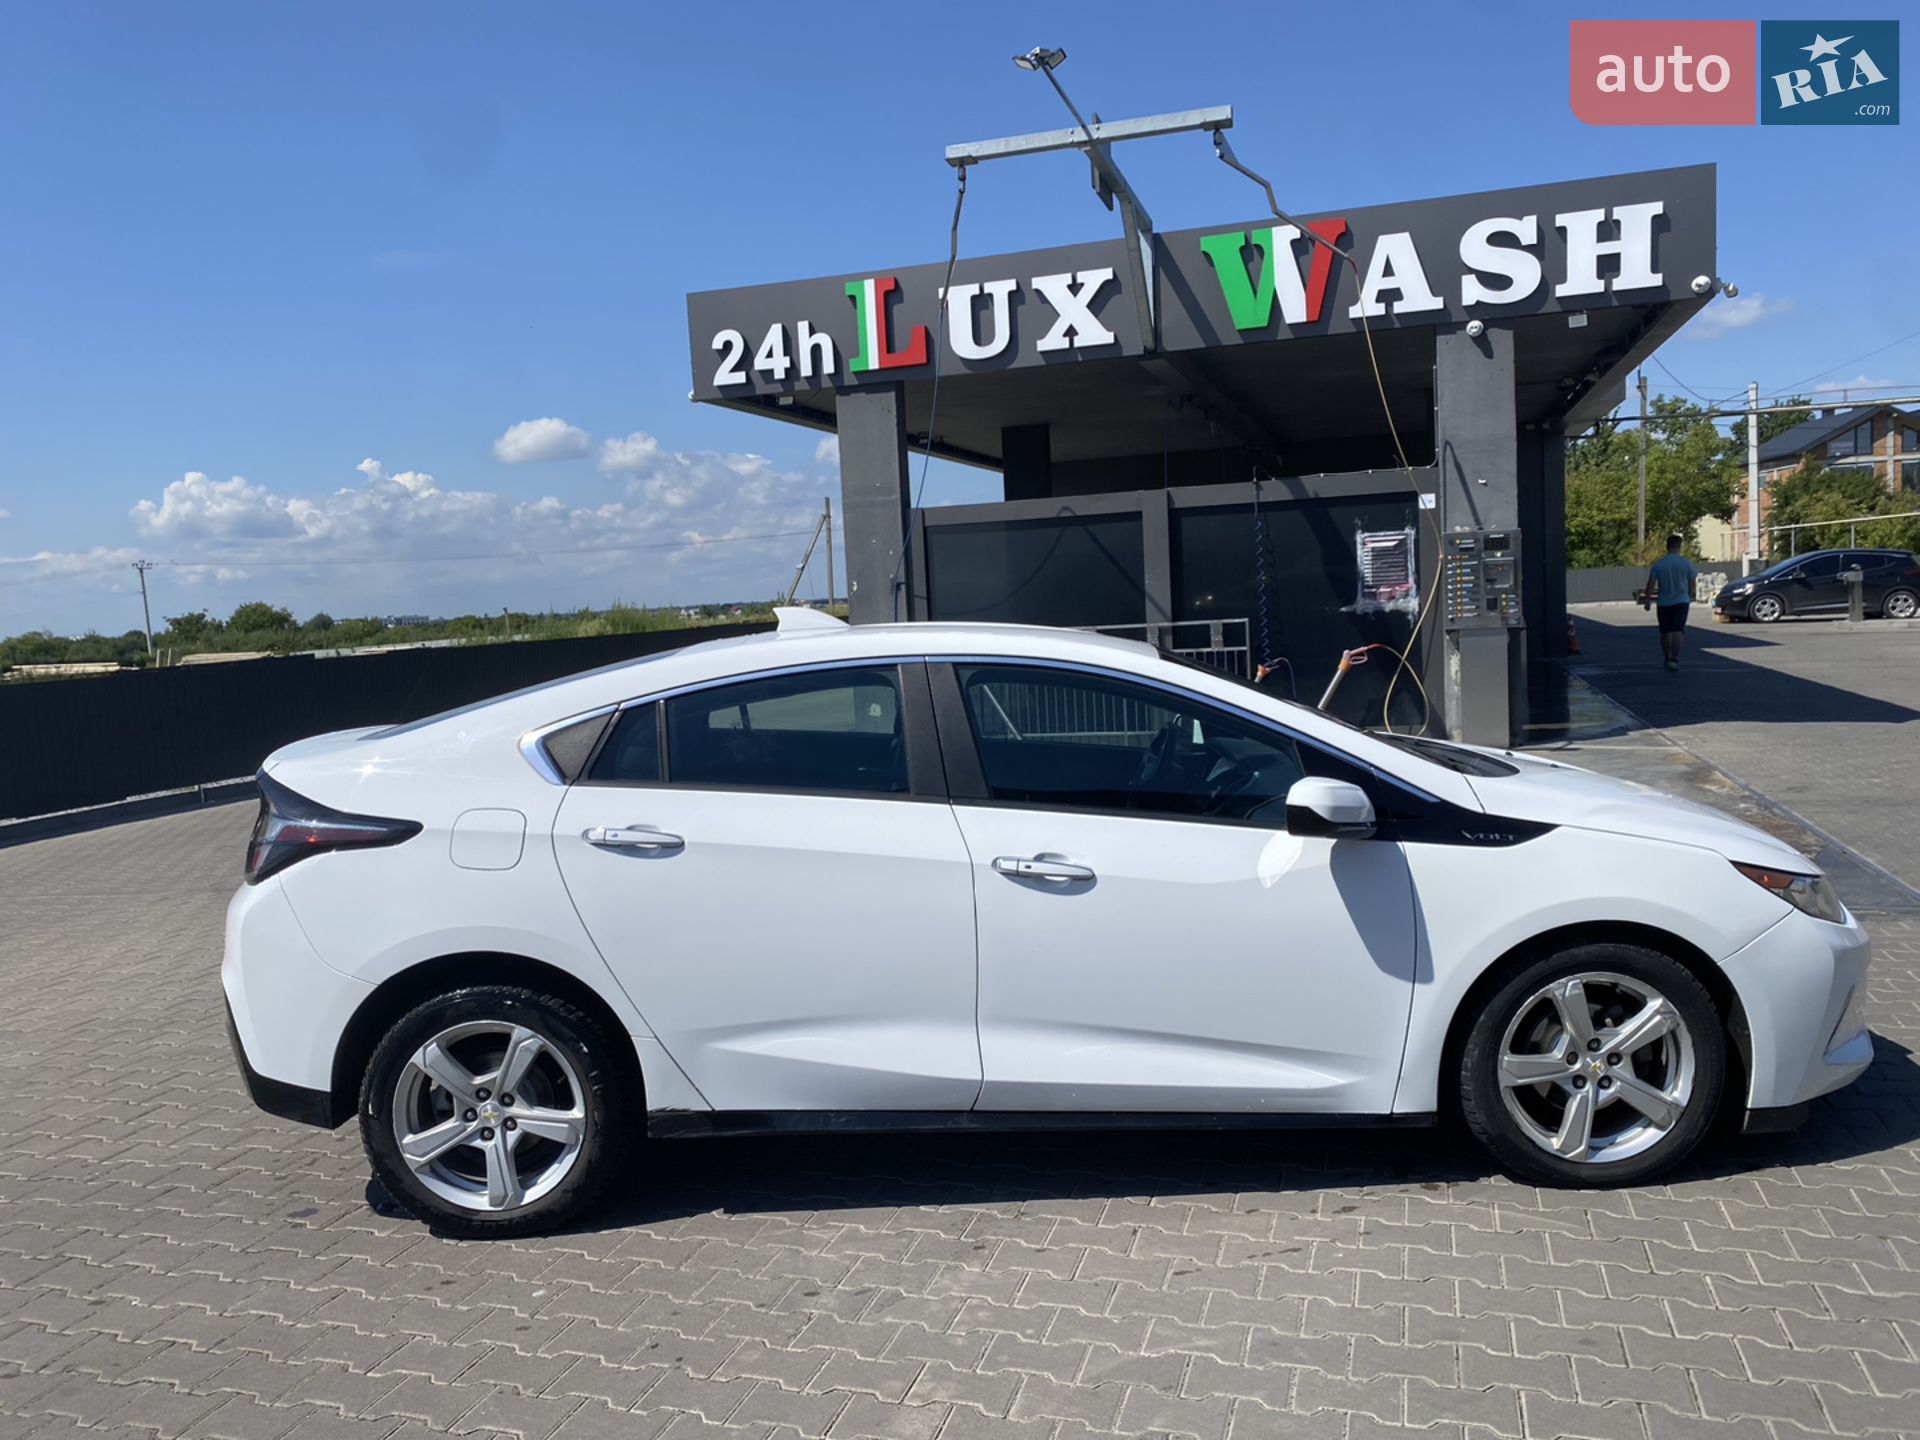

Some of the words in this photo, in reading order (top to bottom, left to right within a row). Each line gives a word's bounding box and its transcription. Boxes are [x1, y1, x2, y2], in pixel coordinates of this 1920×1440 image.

[711, 320, 836, 387] 24h
[845, 267, 1116, 373] LUX
[1200, 200, 1664, 330] WASH
